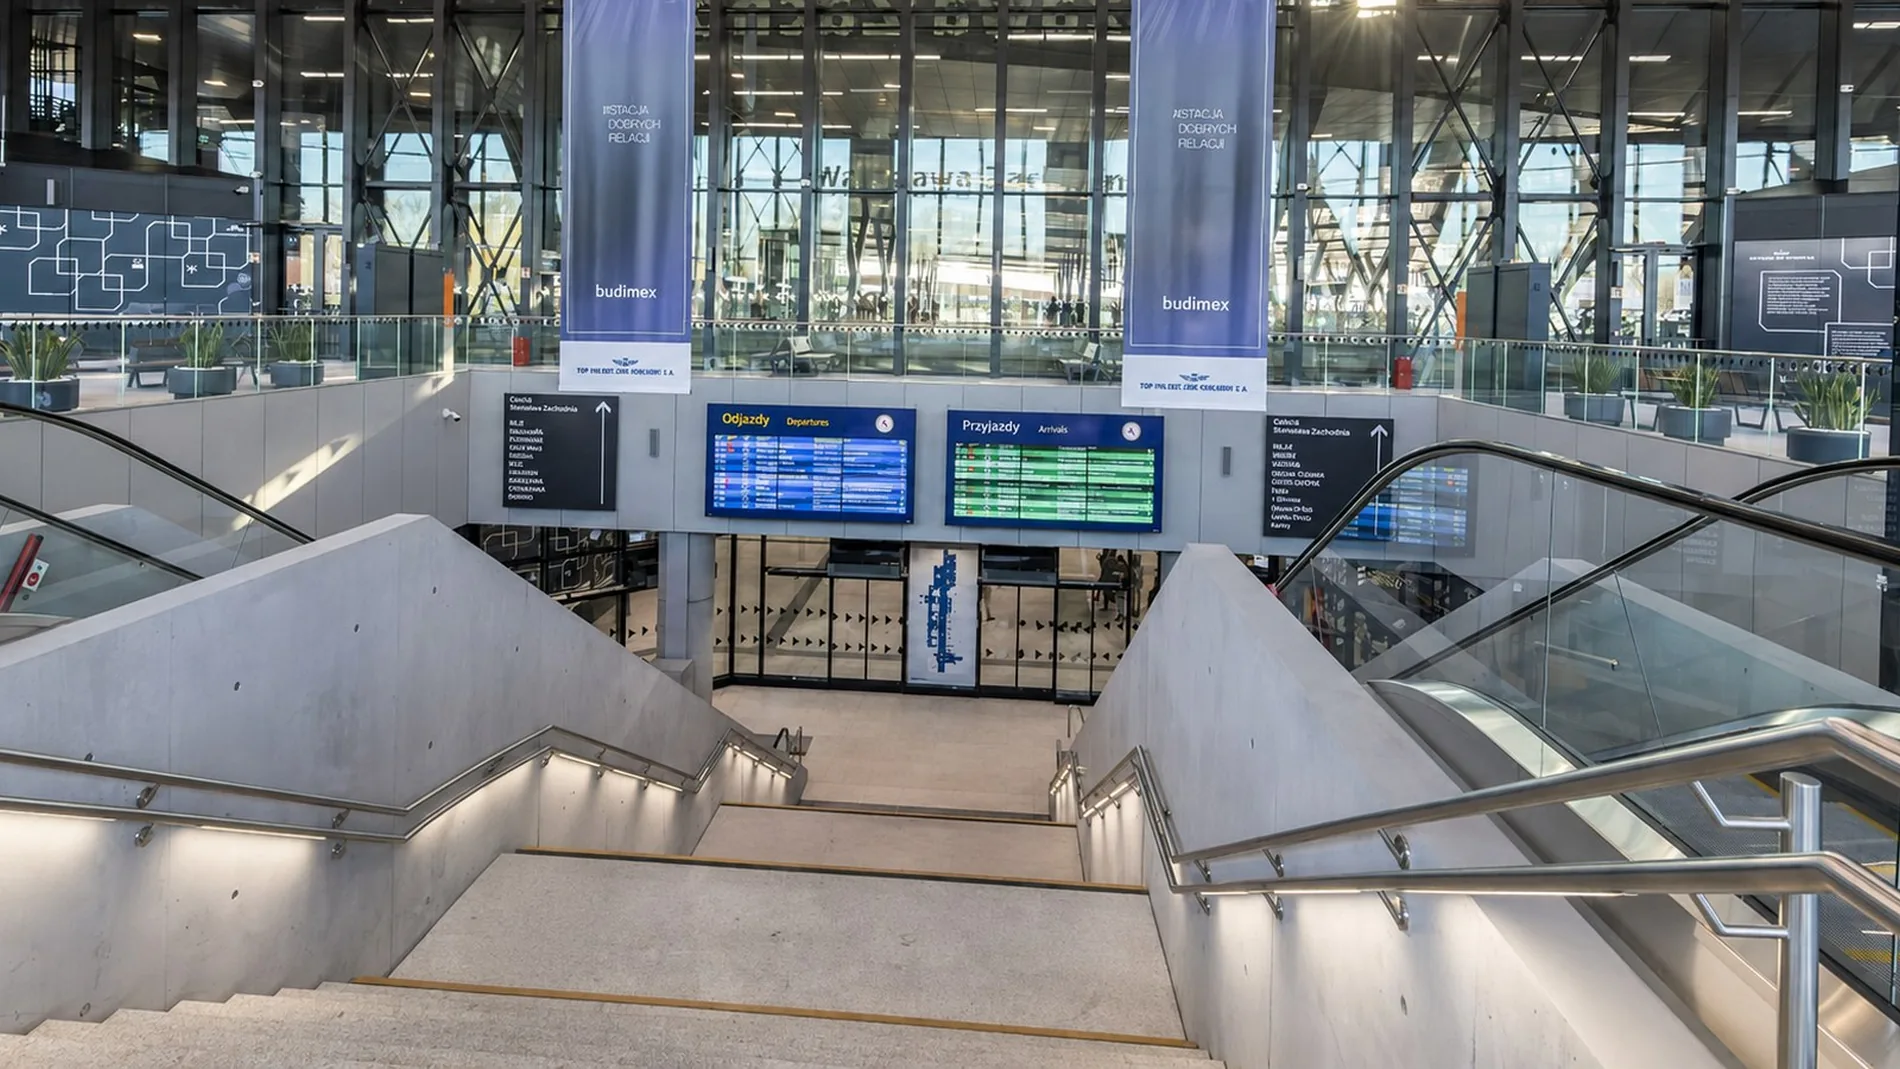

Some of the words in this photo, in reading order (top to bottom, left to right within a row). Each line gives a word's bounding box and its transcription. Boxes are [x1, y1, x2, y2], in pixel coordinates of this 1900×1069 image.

[1178, 123, 1237, 134] DOBRYCH
[595, 284, 658, 299] budimex
[1162, 295, 1231, 312] budimex
[722, 412, 770, 428] Odjazdy
[786, 416, 830, 428] Departures
[962, 419, 1021, 436] Przyjazdy
[1038, 424, 1069, 435] Arrivals
